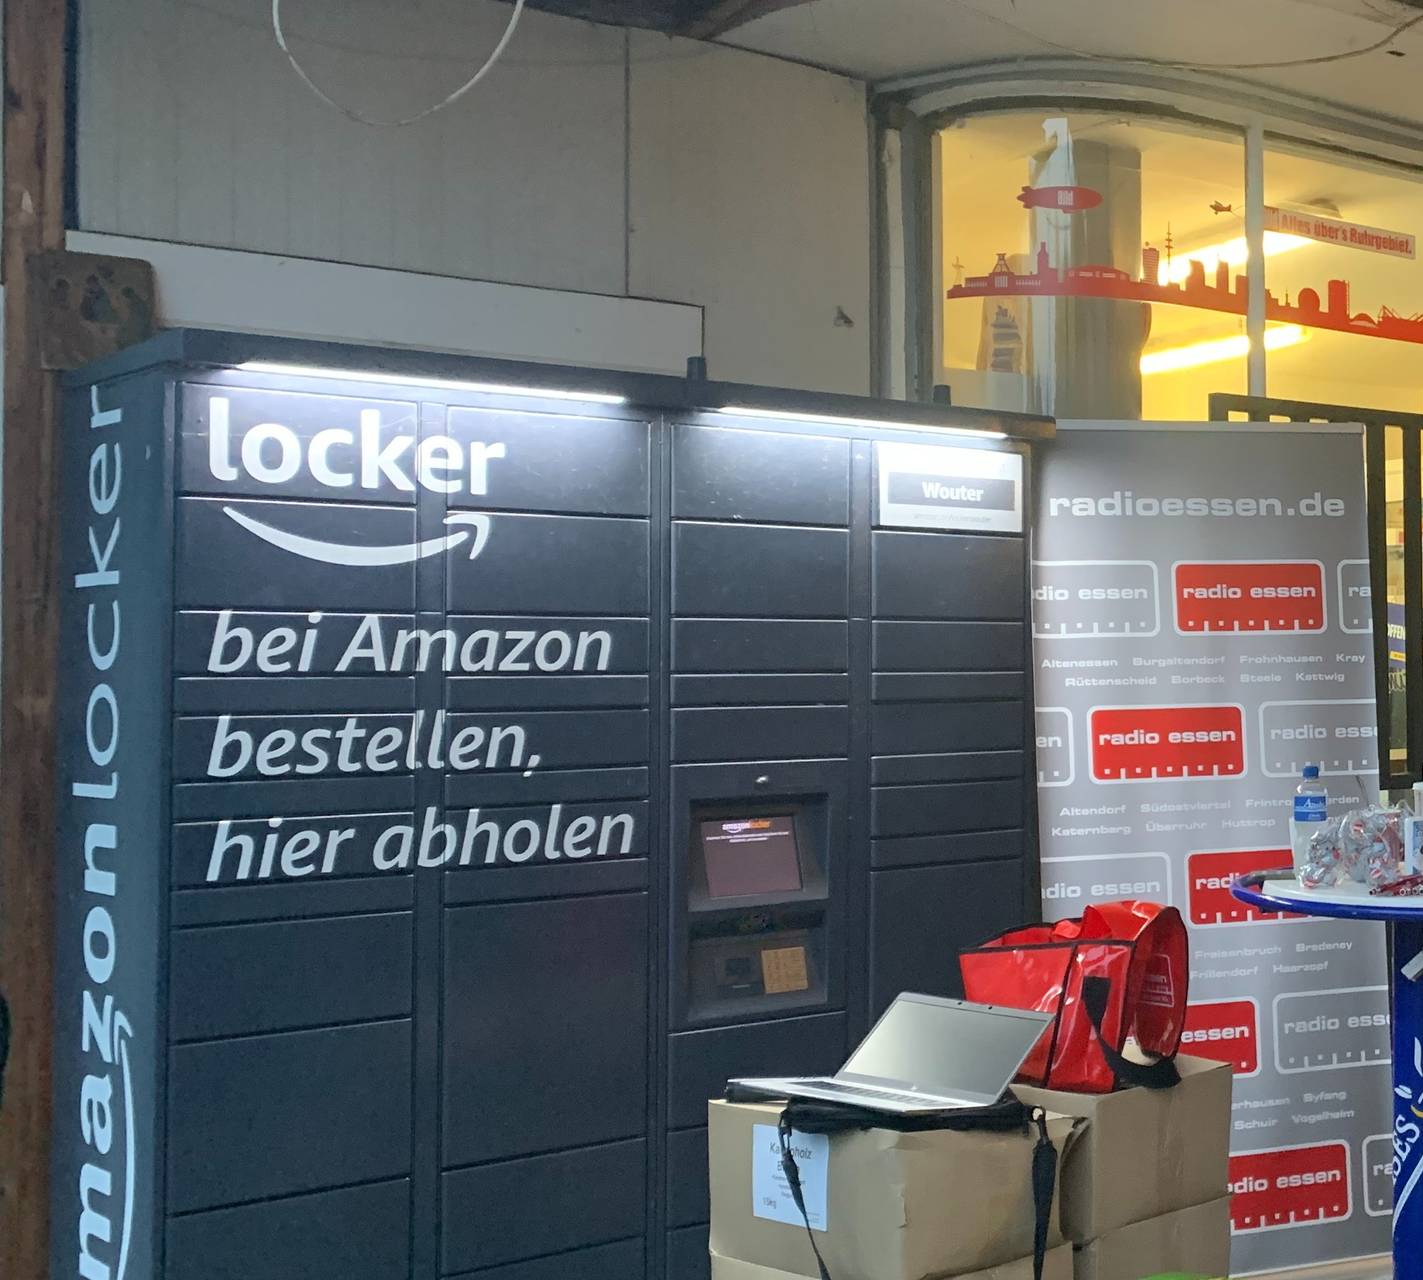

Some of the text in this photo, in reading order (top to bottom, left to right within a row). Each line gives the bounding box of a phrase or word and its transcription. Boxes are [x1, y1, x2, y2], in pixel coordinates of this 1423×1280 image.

[1281, 214, 1310, 234] Alles
[208, 397, 505, 495] locker
[921, 481, 984, 502] Wouter
[1050, 491, 1345, 517] radioessen.de
[1078, 588, 1148, 600] essen
[1183, 584, 1316, 599] radio essen
[206, 609, 612, 673] bei Amazon
[1041, 653, 1366, 668] Altenessen Burgaltendorf Frohnhausen Kray
[1065, 672, 1345, 688] Rüttenscheid Borbeck Steele Kettwig
[1099, 729, 1236, 745] radio essen
[1270, 724, 1377, 740] radio ess
[206, 709, 541, 777] bestellen,
[1059, 804, 1126, 817] Altendorf
[1245, 798, 1293, 809] Frintro
[1327, 795, 1360, 806] erden
[1052, 817, 1275, 837] Katernberg Überruhr Huttrop
[206, 804, 635, 882] hier abholen
[1091, 880, 1160, 896] essen
[1295, 941, 1352, 953] Bredeney
[1190, 961, 1329, 979] Frillendorf Haarzopf
[1181, 1025, 1249, 1043] essen
[1284, 1016, 1339, 1034] radio
[1276, 1169, 1341, 1188] essen
